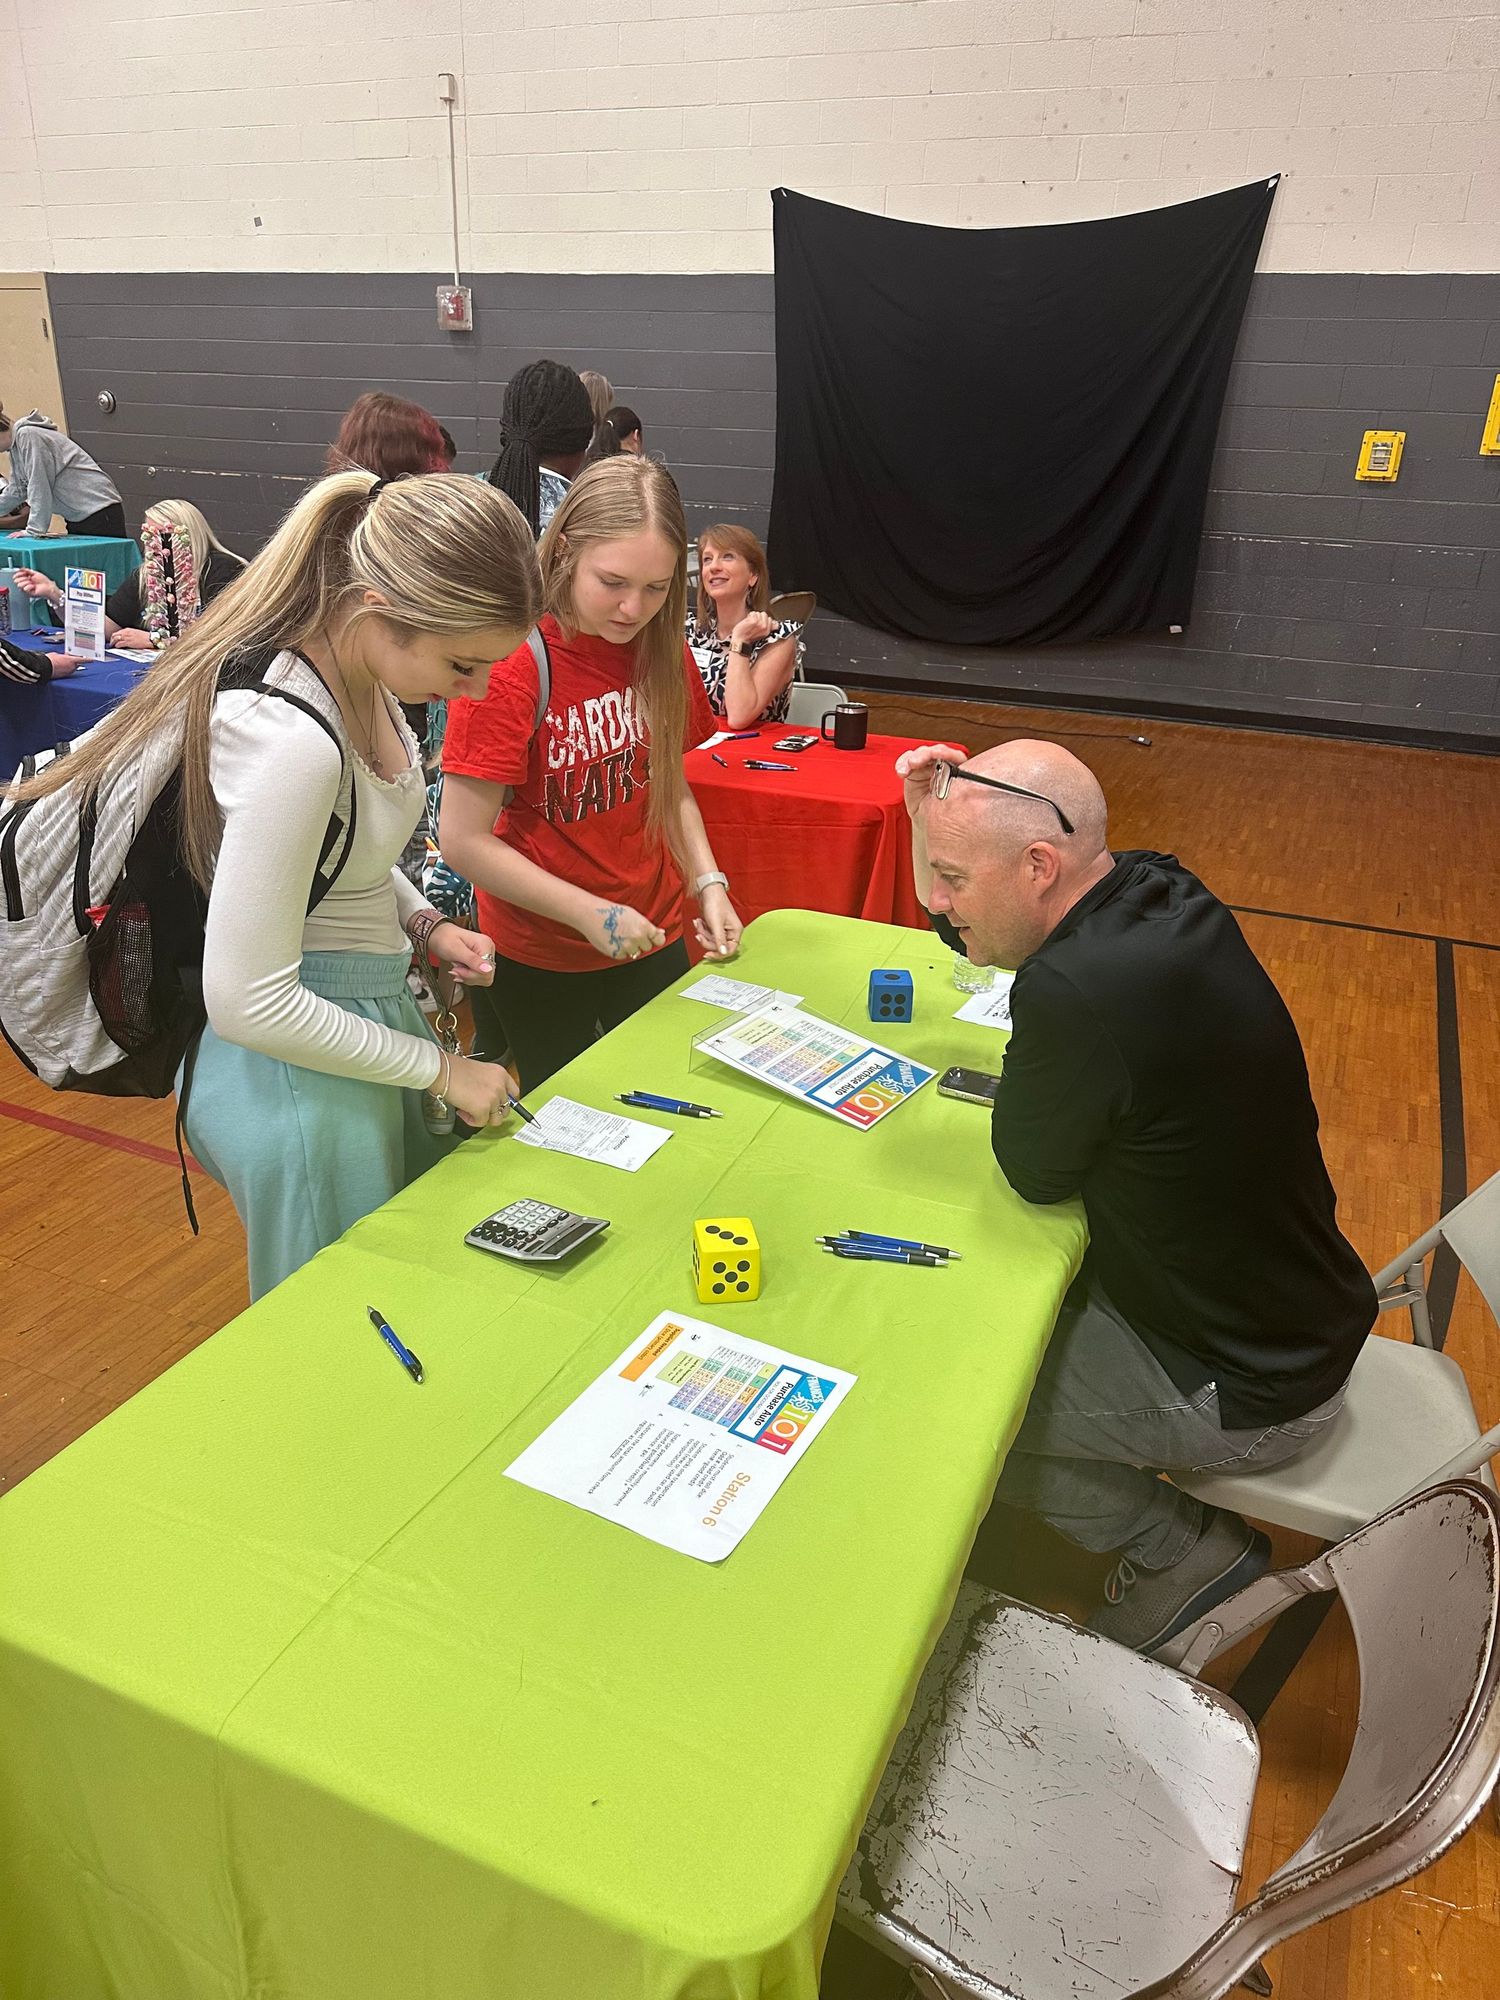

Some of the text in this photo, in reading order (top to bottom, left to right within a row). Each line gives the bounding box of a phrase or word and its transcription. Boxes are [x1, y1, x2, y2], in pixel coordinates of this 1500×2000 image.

[84, 572, 102, 590] 101
[545, 686, 650, 769] CARDI
[849, 1062, 884, 1086] Purchase
[833, 1082, 857, 1097] Auto
[839, 1084, 897, 1121] 101
[651, 1341, 668, 1356] Needed
[765, 1381, 795, 1411] Purchase
[752, 1408, 773, 1427] Auto
[631, 1419, 648, 1435] register
[636, 1422, 655, 1439] Subtract
[759, 1406, 809, 1450] 101
[619, 1439, 630, 1448] one
[630, 1438, 640, 1446] the
[648, 1427, 668, 1447] insurance
[668, 1432, 681, 1444] Total
[608, 1446, 624, 1459] entry
[621, 1445, 634, 1456] total
[638, 1449, 648, 1458] gas
[662, 1442, 672, 1450] car
[664, 1437, 695, 1468] transportation)
[685, 1439, 701, 1454] option
[690, 1442, 708, 1459] Student
[606, 1454, 625, 1472] amount
[636, 1448, 659, 1470] good/bad
[646, 1448, 667, 1467] payment
[680, 1457, 695, 1469] picks
[716, 1450, 728, 1461] Odd
[717, 1453, 735, 1470] Student
[597, 1470, 611, 1482] from
[624, 1468, 641, 1484] credit)
[628, 1469, 649, 1488] monthly
[664, 1468, 677, 1480] used
[674, 1467, 686, 1477] one
[686, 1472, 701, 1487] credit
[695, 1473, 710, 1487] credit
[709, 1469, 722, 1481] must
[586, 1481, 602, 1495] check
[658, 1478, 668, 1486] car
[702, 1480, 714, 1489] roll
[612, 1486, 634, 1507] payment
[641, 1490, 658, 1506] public
[648, 1475, 679, 1508] transportation
[699, 1471, 752, 1528] Station 6
